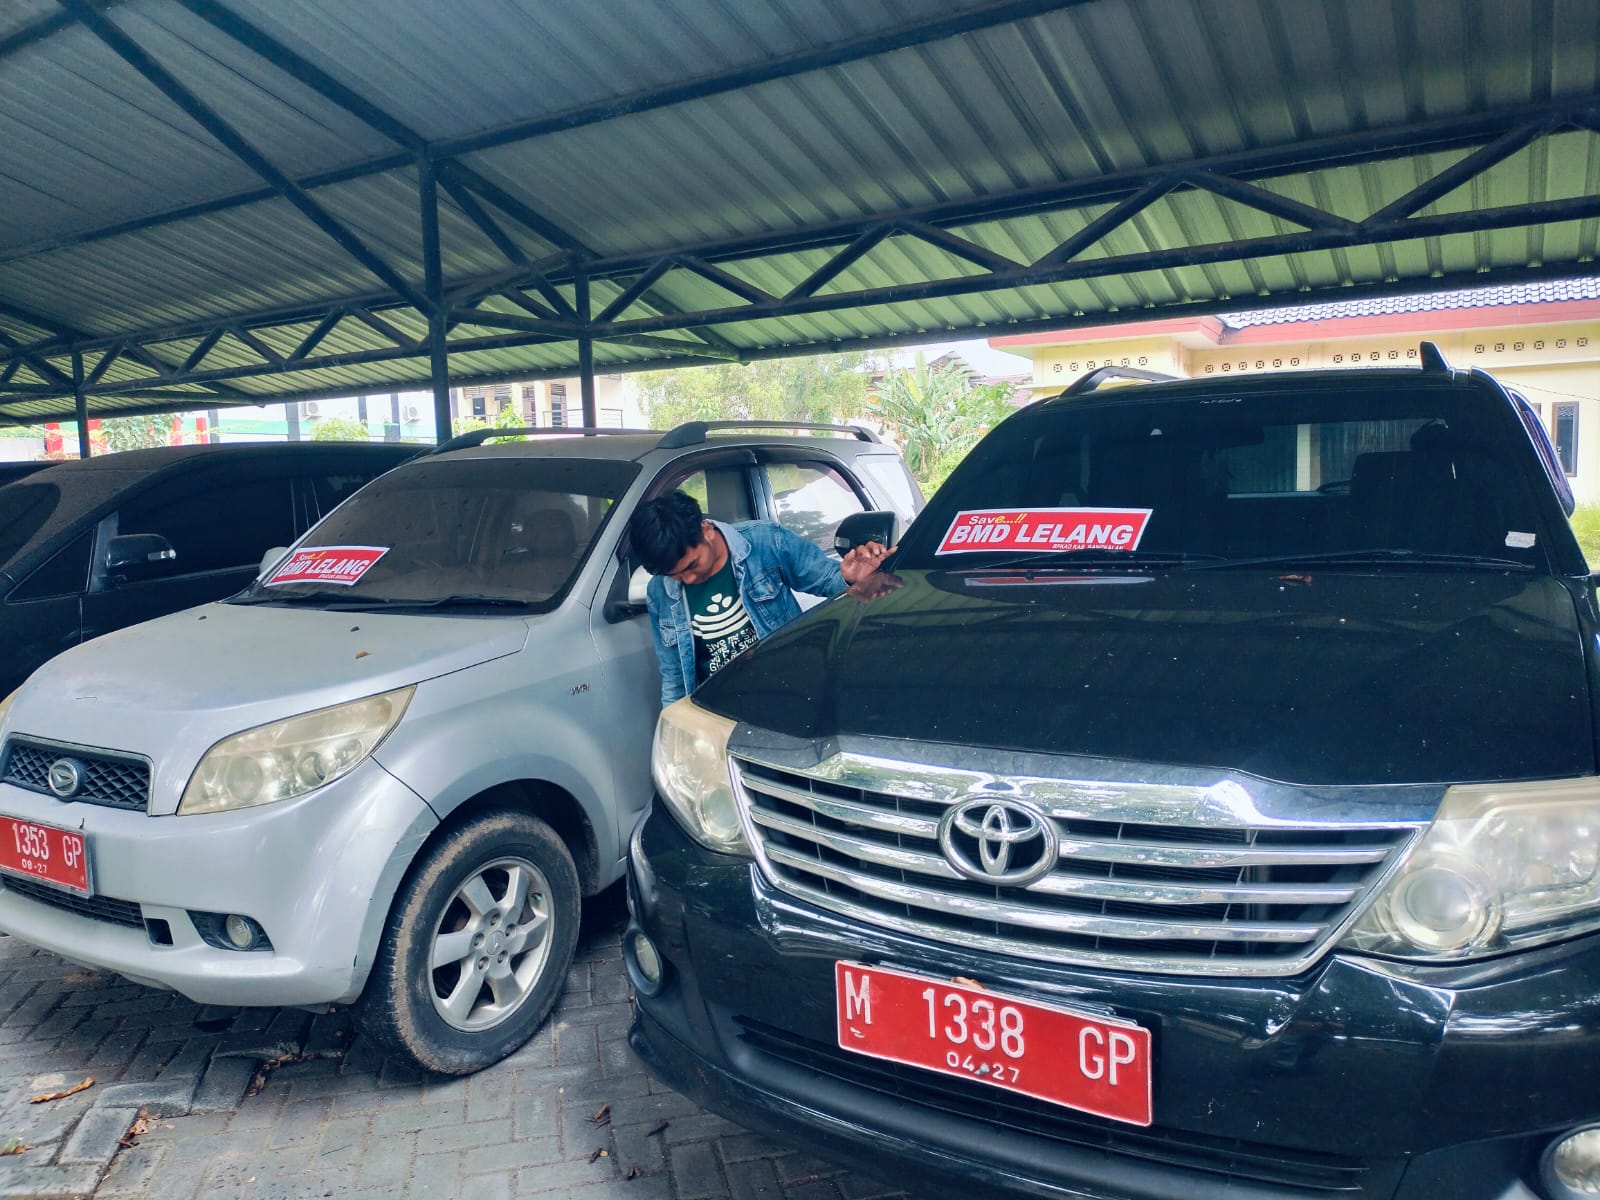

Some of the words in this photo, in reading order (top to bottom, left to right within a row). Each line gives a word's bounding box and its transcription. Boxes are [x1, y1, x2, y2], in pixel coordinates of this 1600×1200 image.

[949, 524, 1010, 544] BMD
[1014, 523, 1133, 545] LELANG
[305, 558, 370, 575] LELANG
[12, 823, 49, 860] 1353
[62, 835, 82, 869] GP
[844, 970, 873, 1025] M
[921, 987, 1025, 1059] 1338
[1078, 1026, 1136, 1086] GP
